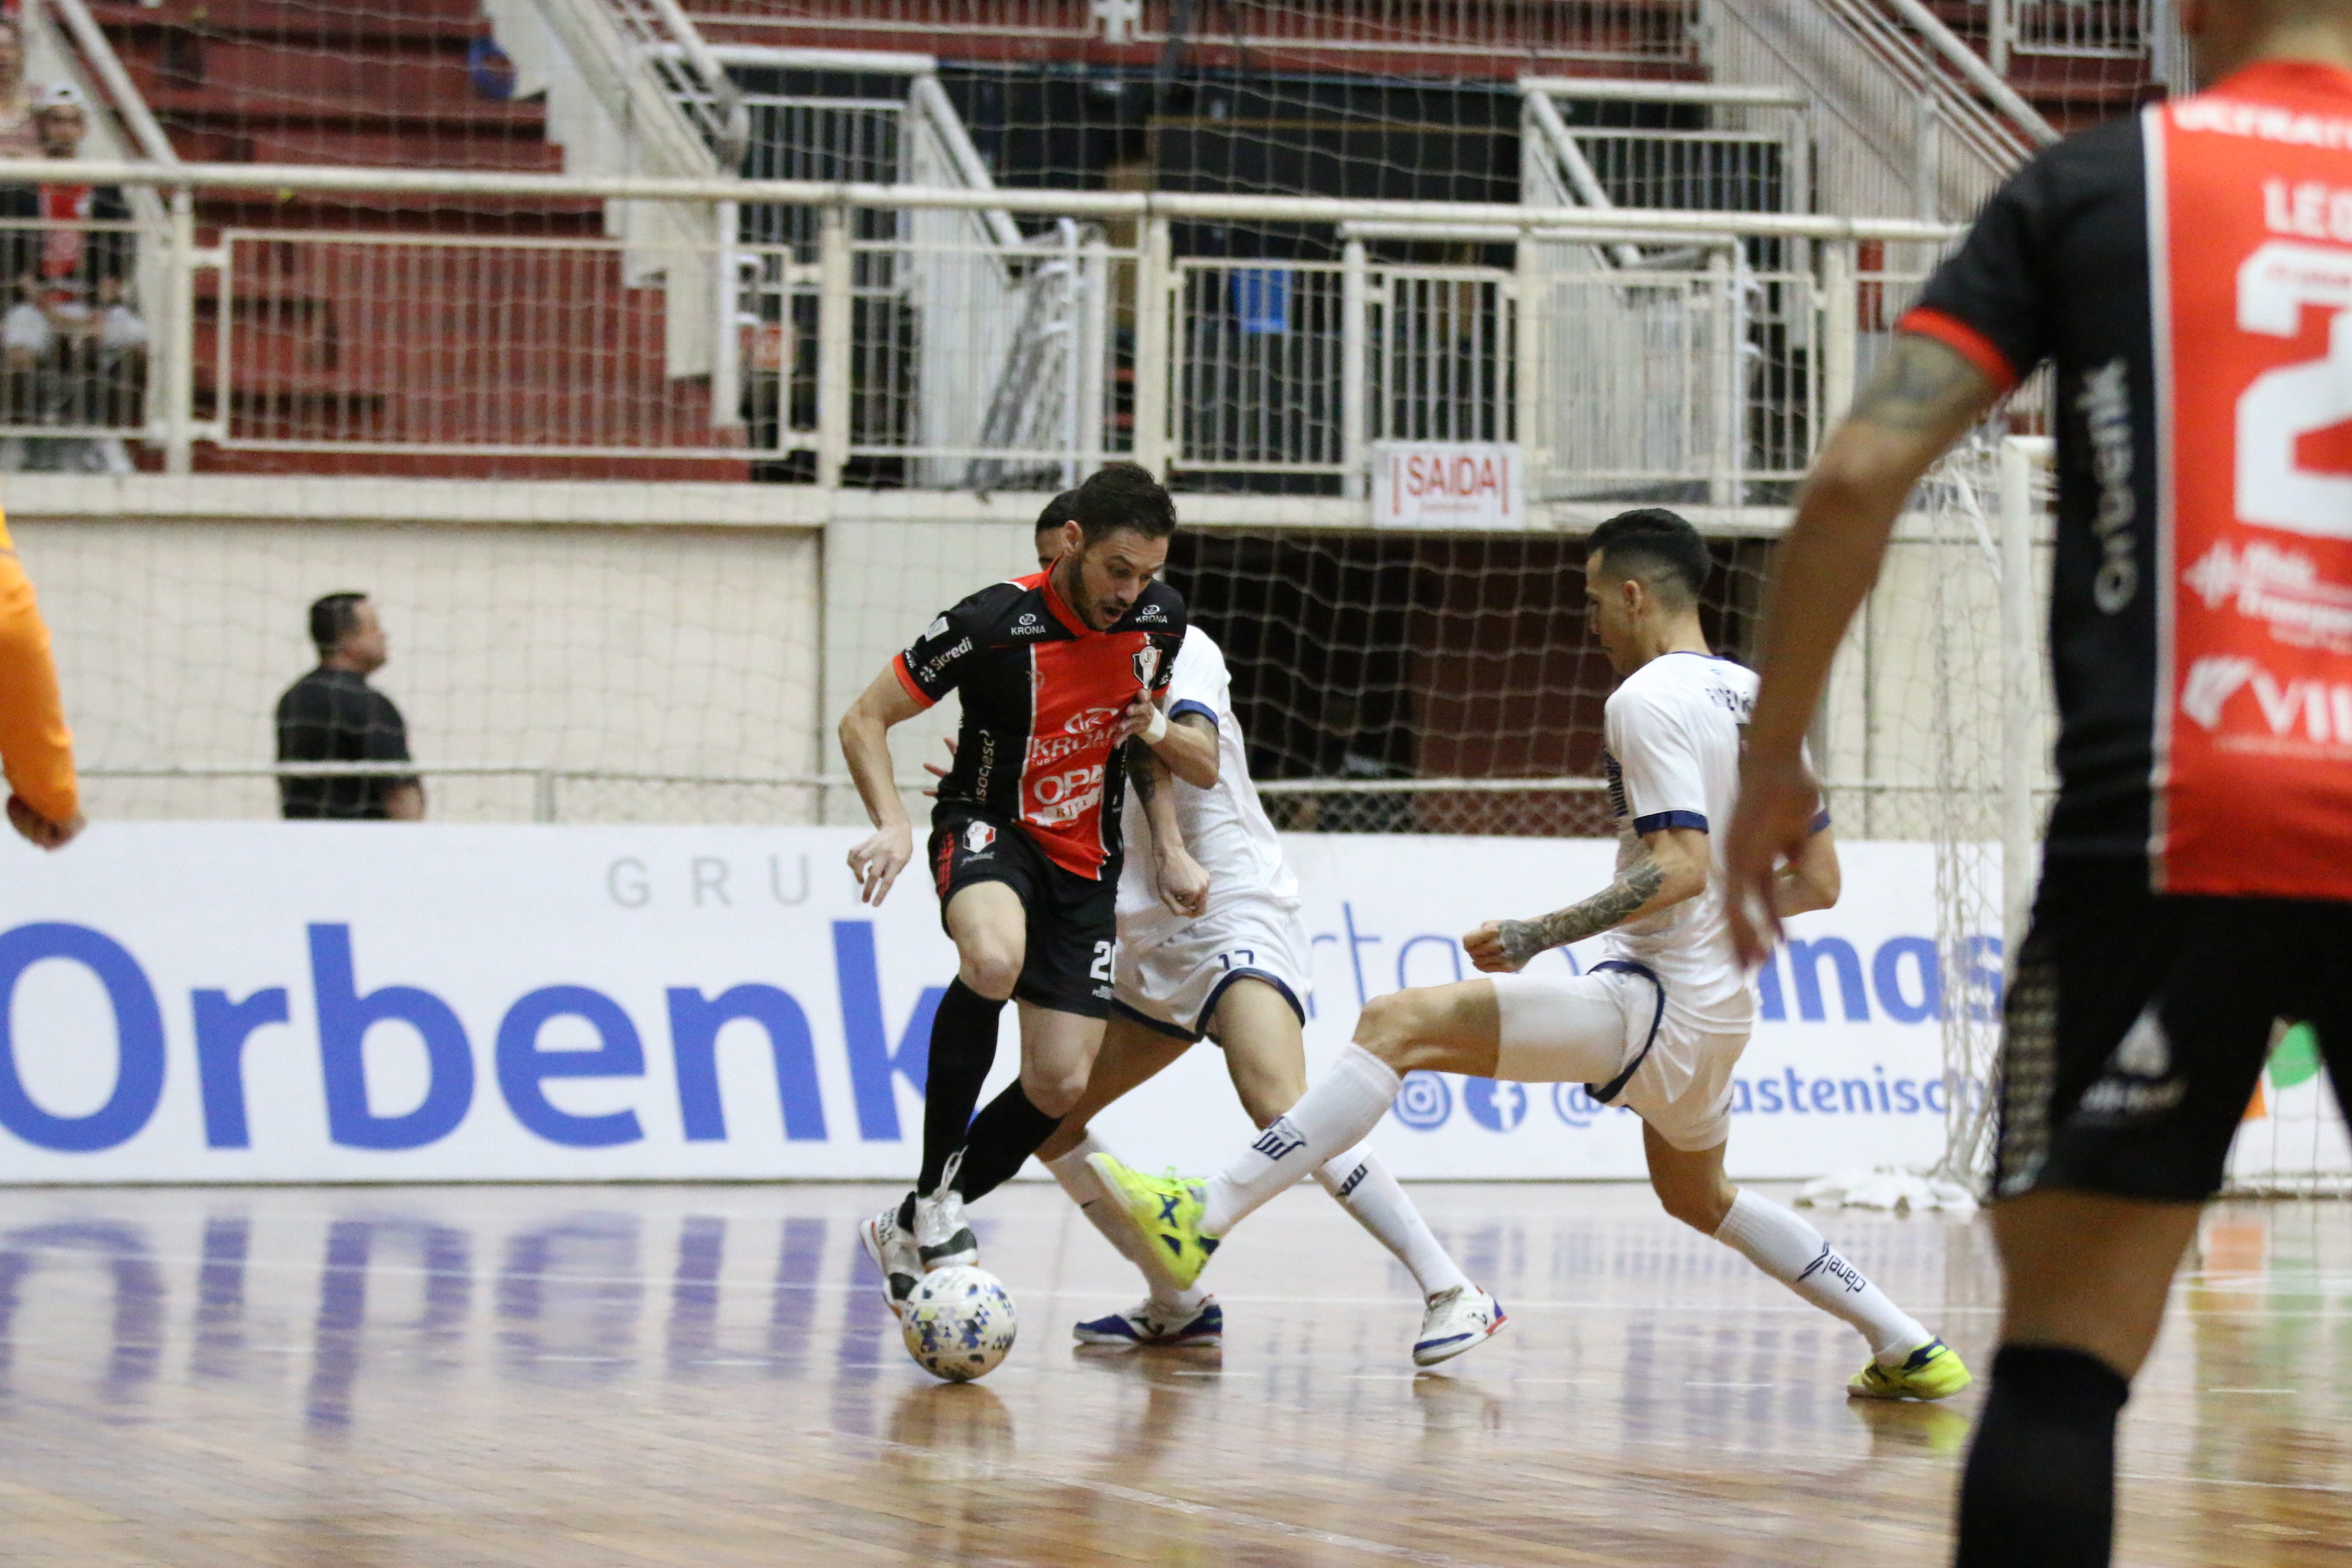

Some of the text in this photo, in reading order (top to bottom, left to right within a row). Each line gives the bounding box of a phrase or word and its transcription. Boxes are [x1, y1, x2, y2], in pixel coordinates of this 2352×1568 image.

[1010, 625, 1046, 635] KRONA
[1136, 615, 1168, 623] KRONA
[929, 636, 973, 671] Sicredi
[608, 854, 862, 908] GRU
[0, 920, 950, 1154] Orbenk
